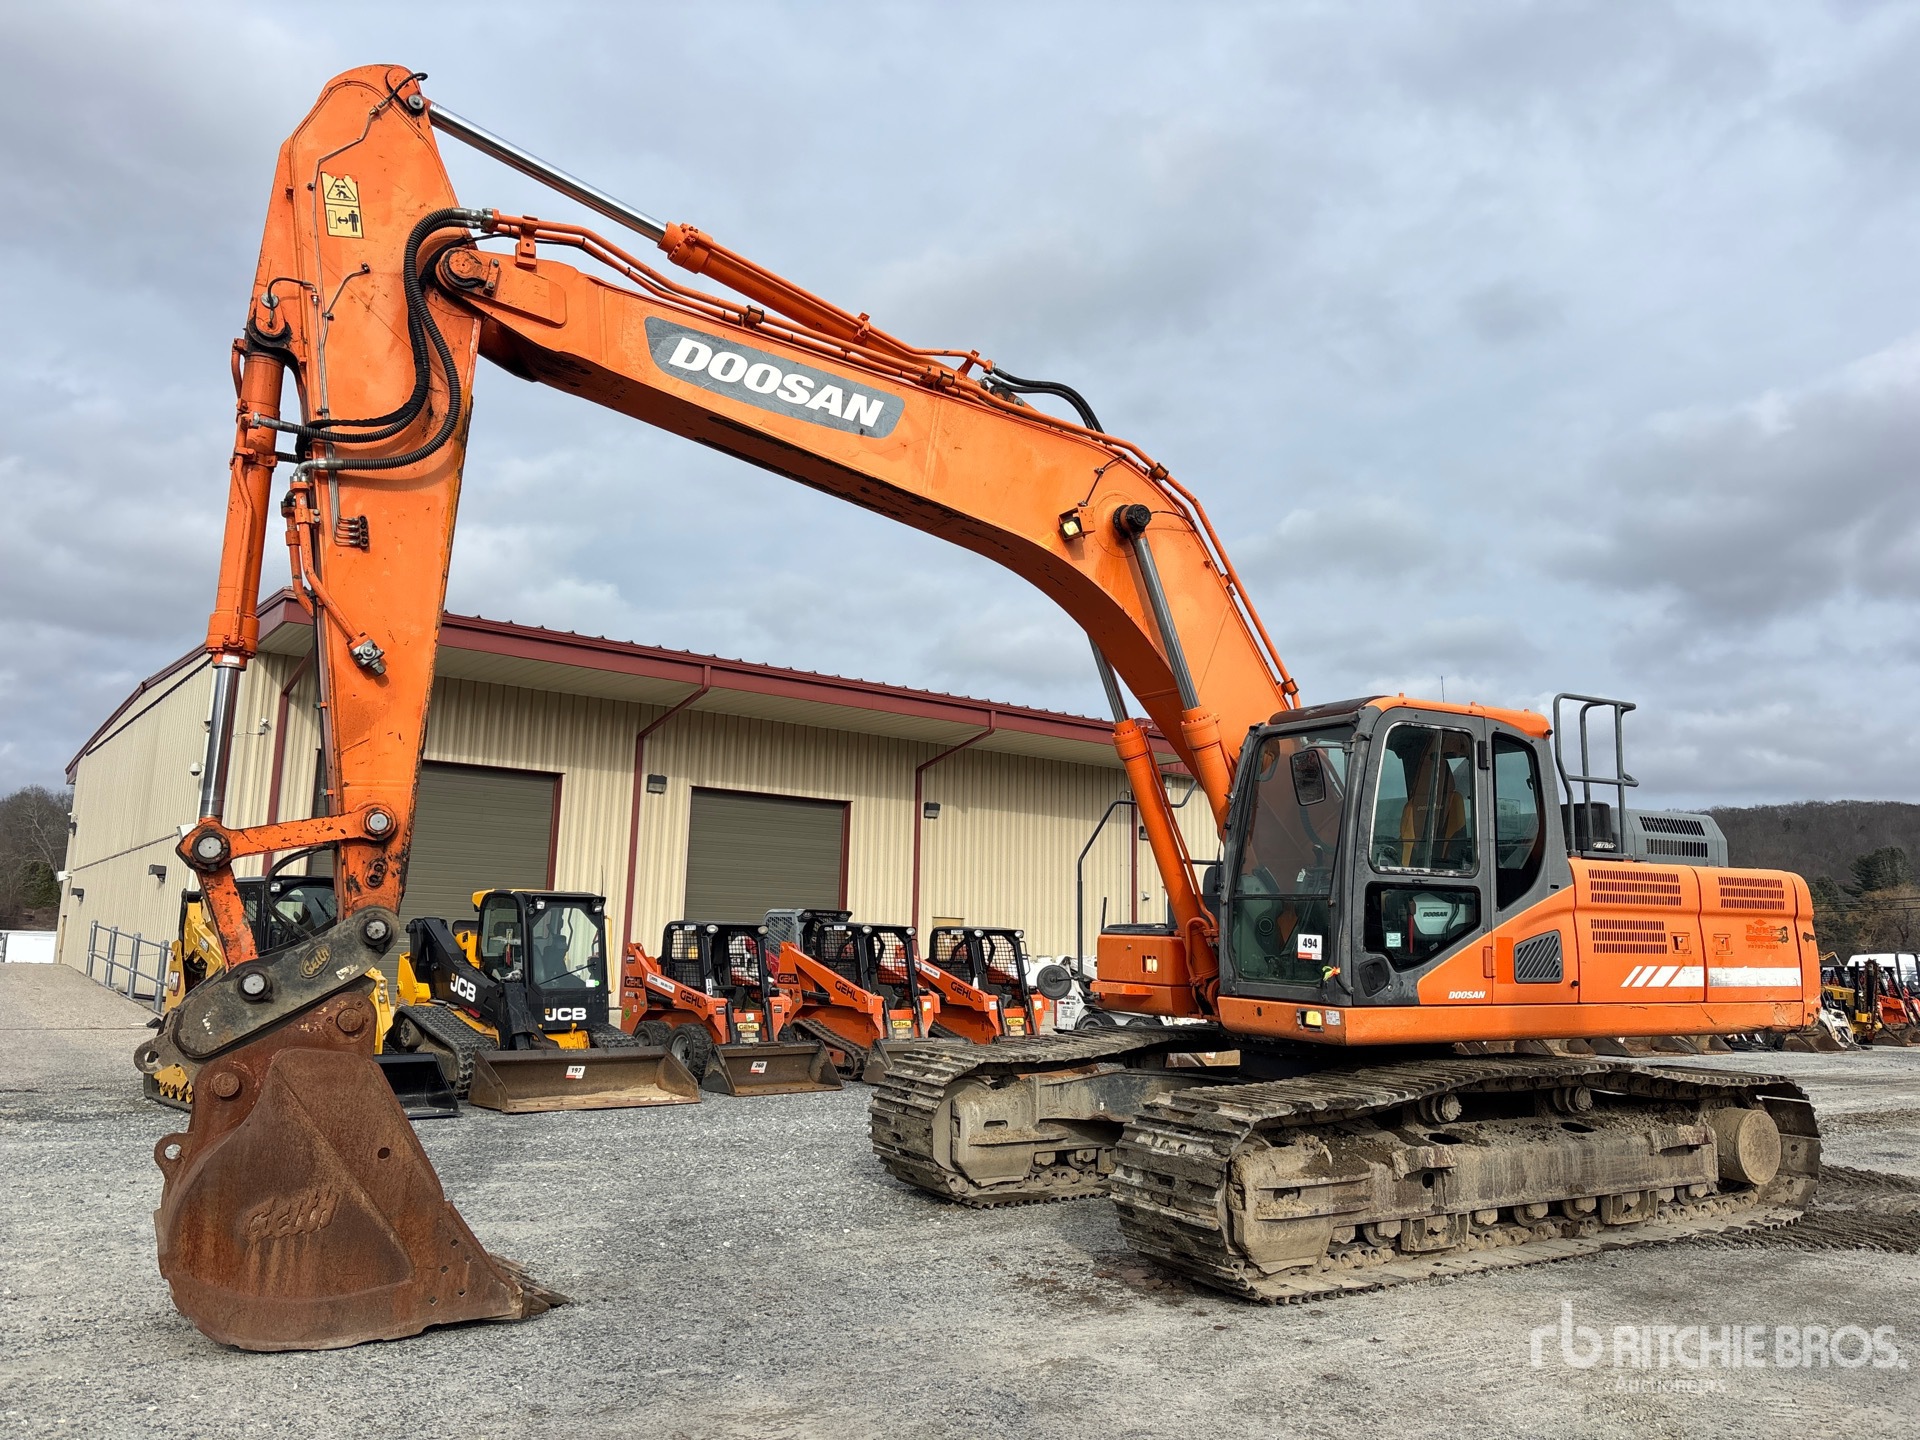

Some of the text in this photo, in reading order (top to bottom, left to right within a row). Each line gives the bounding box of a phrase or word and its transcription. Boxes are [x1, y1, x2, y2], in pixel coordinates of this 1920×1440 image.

[668, 337, 884, 427] DOOSAN
[1303, 938, 1317, 948] 494
[303, 947, 329, 975] Geith
[450, 975, 477, 1003] JCB
[626, 977, 643, 987] GEHL
[778, 974, 798, 984] GEHL
[680, 989, 703, 1009] GEHL
[835, 980, 858, 1002] GEHL
[950, 981, 974, 1002] GEHL
[1448, 990, 1486, 1000] DOOSAN
[544, 1008, 587, 1021] JCB
